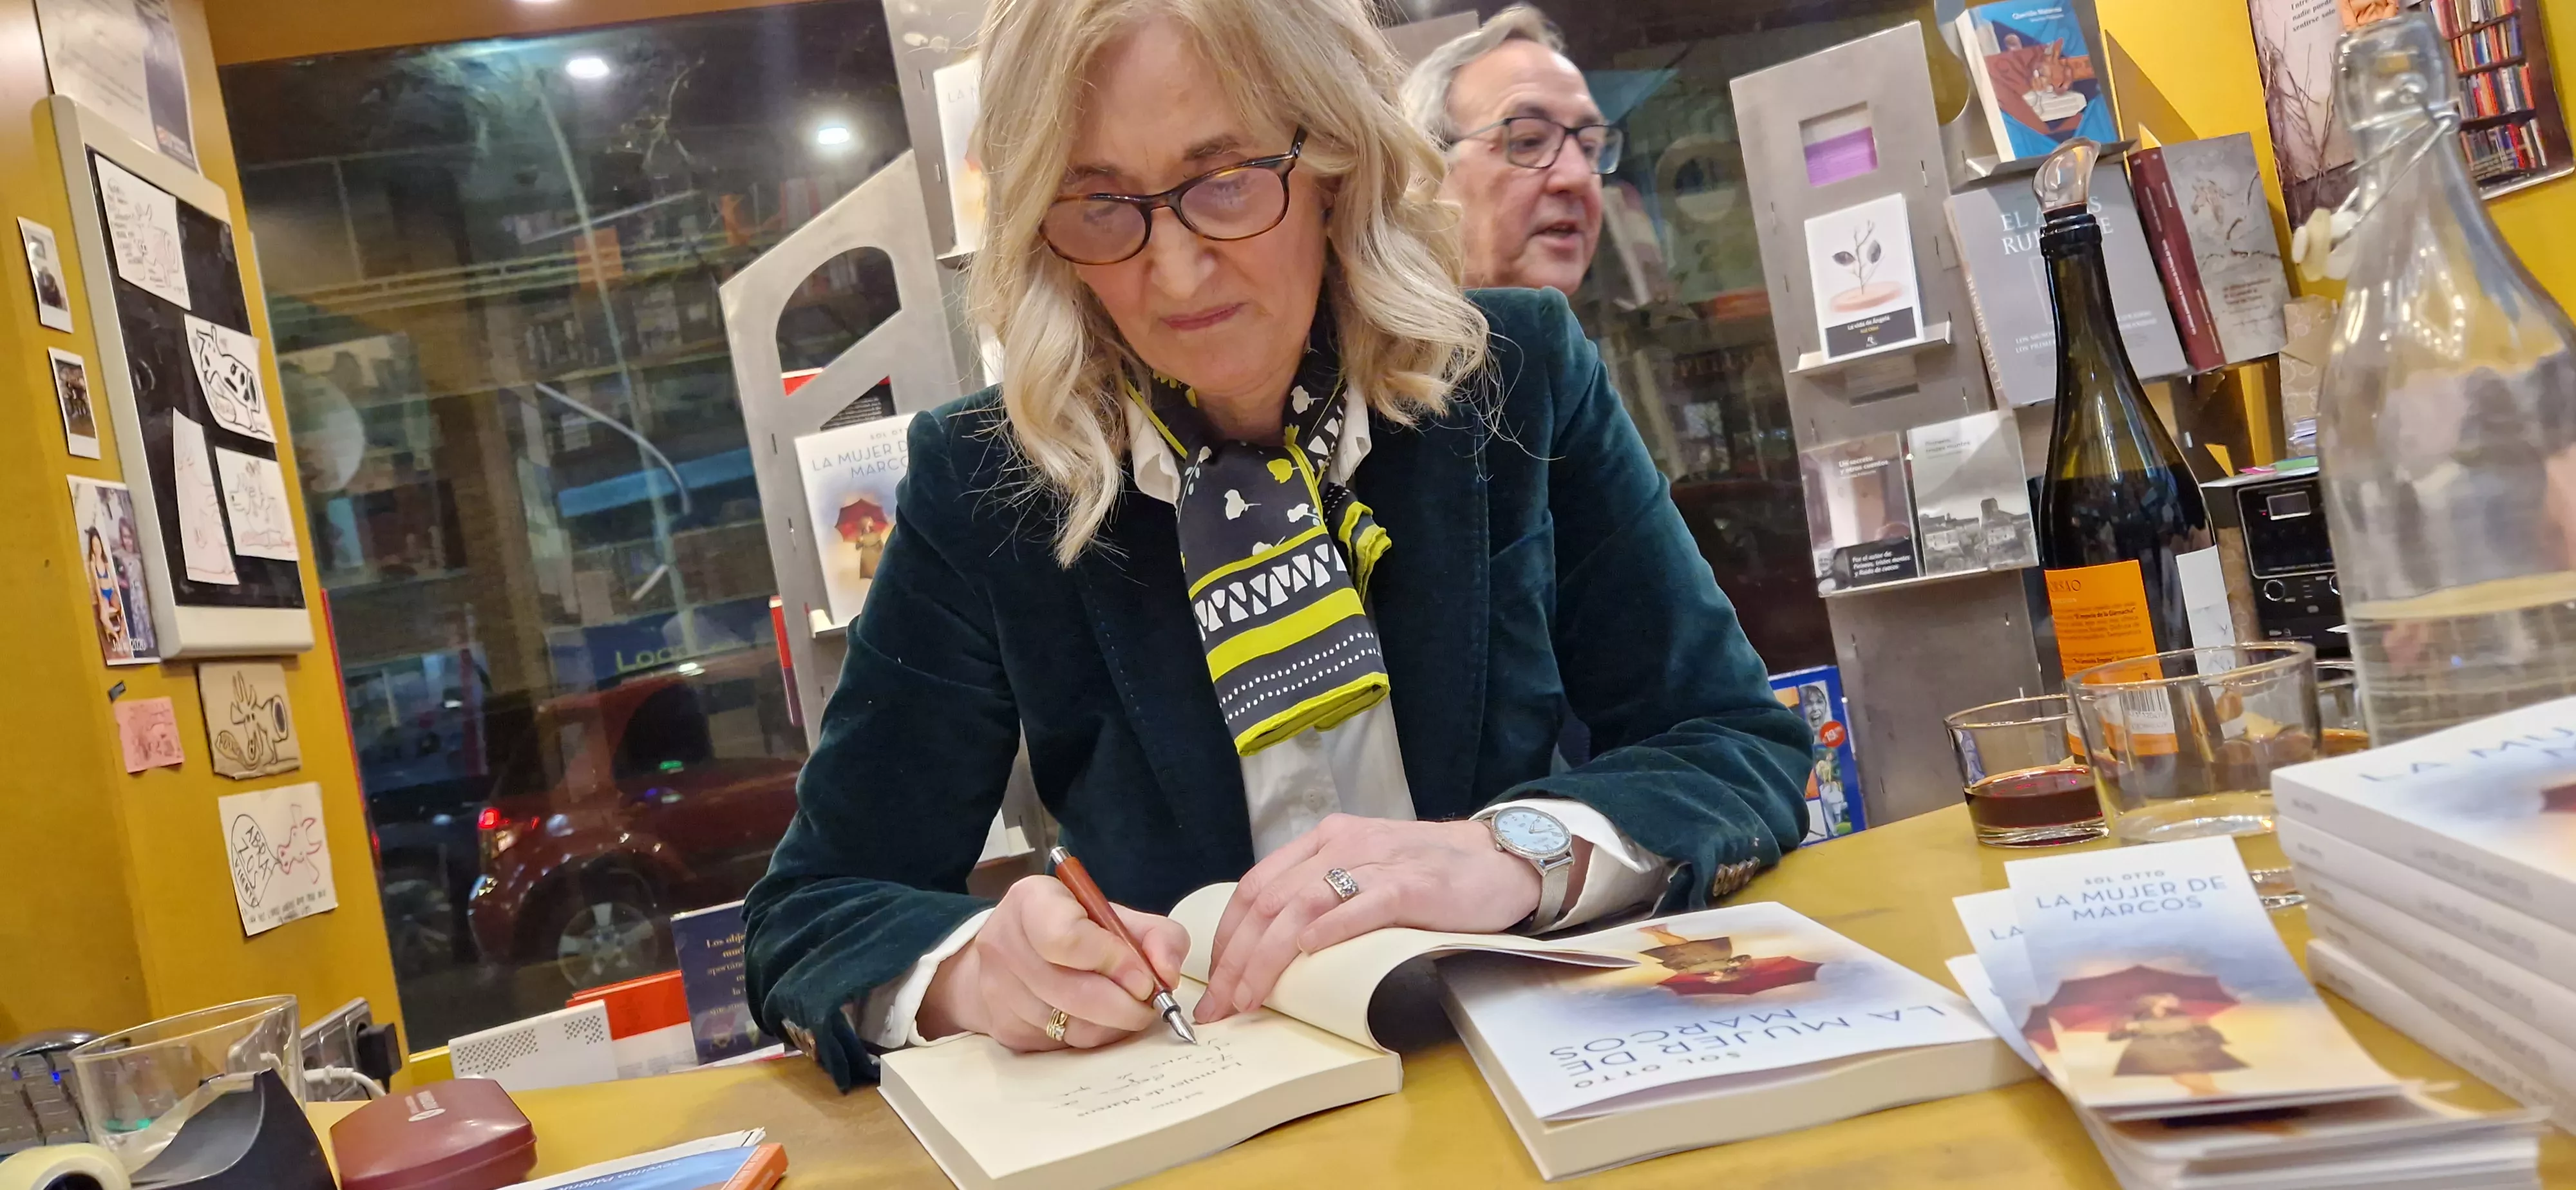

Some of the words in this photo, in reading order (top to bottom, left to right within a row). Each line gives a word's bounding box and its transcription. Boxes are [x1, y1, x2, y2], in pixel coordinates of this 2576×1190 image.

[2292, 8, 2311, 21] nadie
[2293, 16, 2319, 32] sentirse
[2322, 8, 2336, 18] solo
[2000, 211, 2029, 232] EL
[2030, 339, 2056, 351] PRIME
[891, 428, 909, 436] OTT
[811, 457, 833, 472] LA
[838, 443, 892, 466] MUJER
[898, 439, 909, 453] D
[1838, 460, 1848, 468] Un
[1848, 455, 1874, 466] secreto
[851, 456, 909, 478] MARCO
[1845, 464, 1862, 473] otros
[1863, 459, 1889, 470] cuentos
[1868, 552, 1884, 561] autor
[2083, 876, 2114, 886] SOL
[2121, 870, 2165, 882] OTTO
[2036, 893, 2071, 910] LA
[2081, 882, 2177, 903] MUJER
[2188, 874, 2228, 892] DE
[2072, 894, 2204, 922] MARCOS
[706, 938, 723, 949] Los
[724, 933, 745, 945] obje
[1989, 924, 2025, 941] LA
[1866, 1004, 1947, 1023] LA
[1549, 1007, 1798, 1060] MARCOS
[1658, 1015, 1851, 1055] MUJER
[1220, 1061, 1242, 1070] La
[1558, 1050, 1638, 1078] DE
[1677, 1051, 1741, 1065] SOL
[1170, 1069, 1217, 1089] mujer
[1573, 1063, 1662, 1088] OTTO
[1144, 1088, 1164, 1097] de
[1076, 1095, 1141, 1117] Marcos
